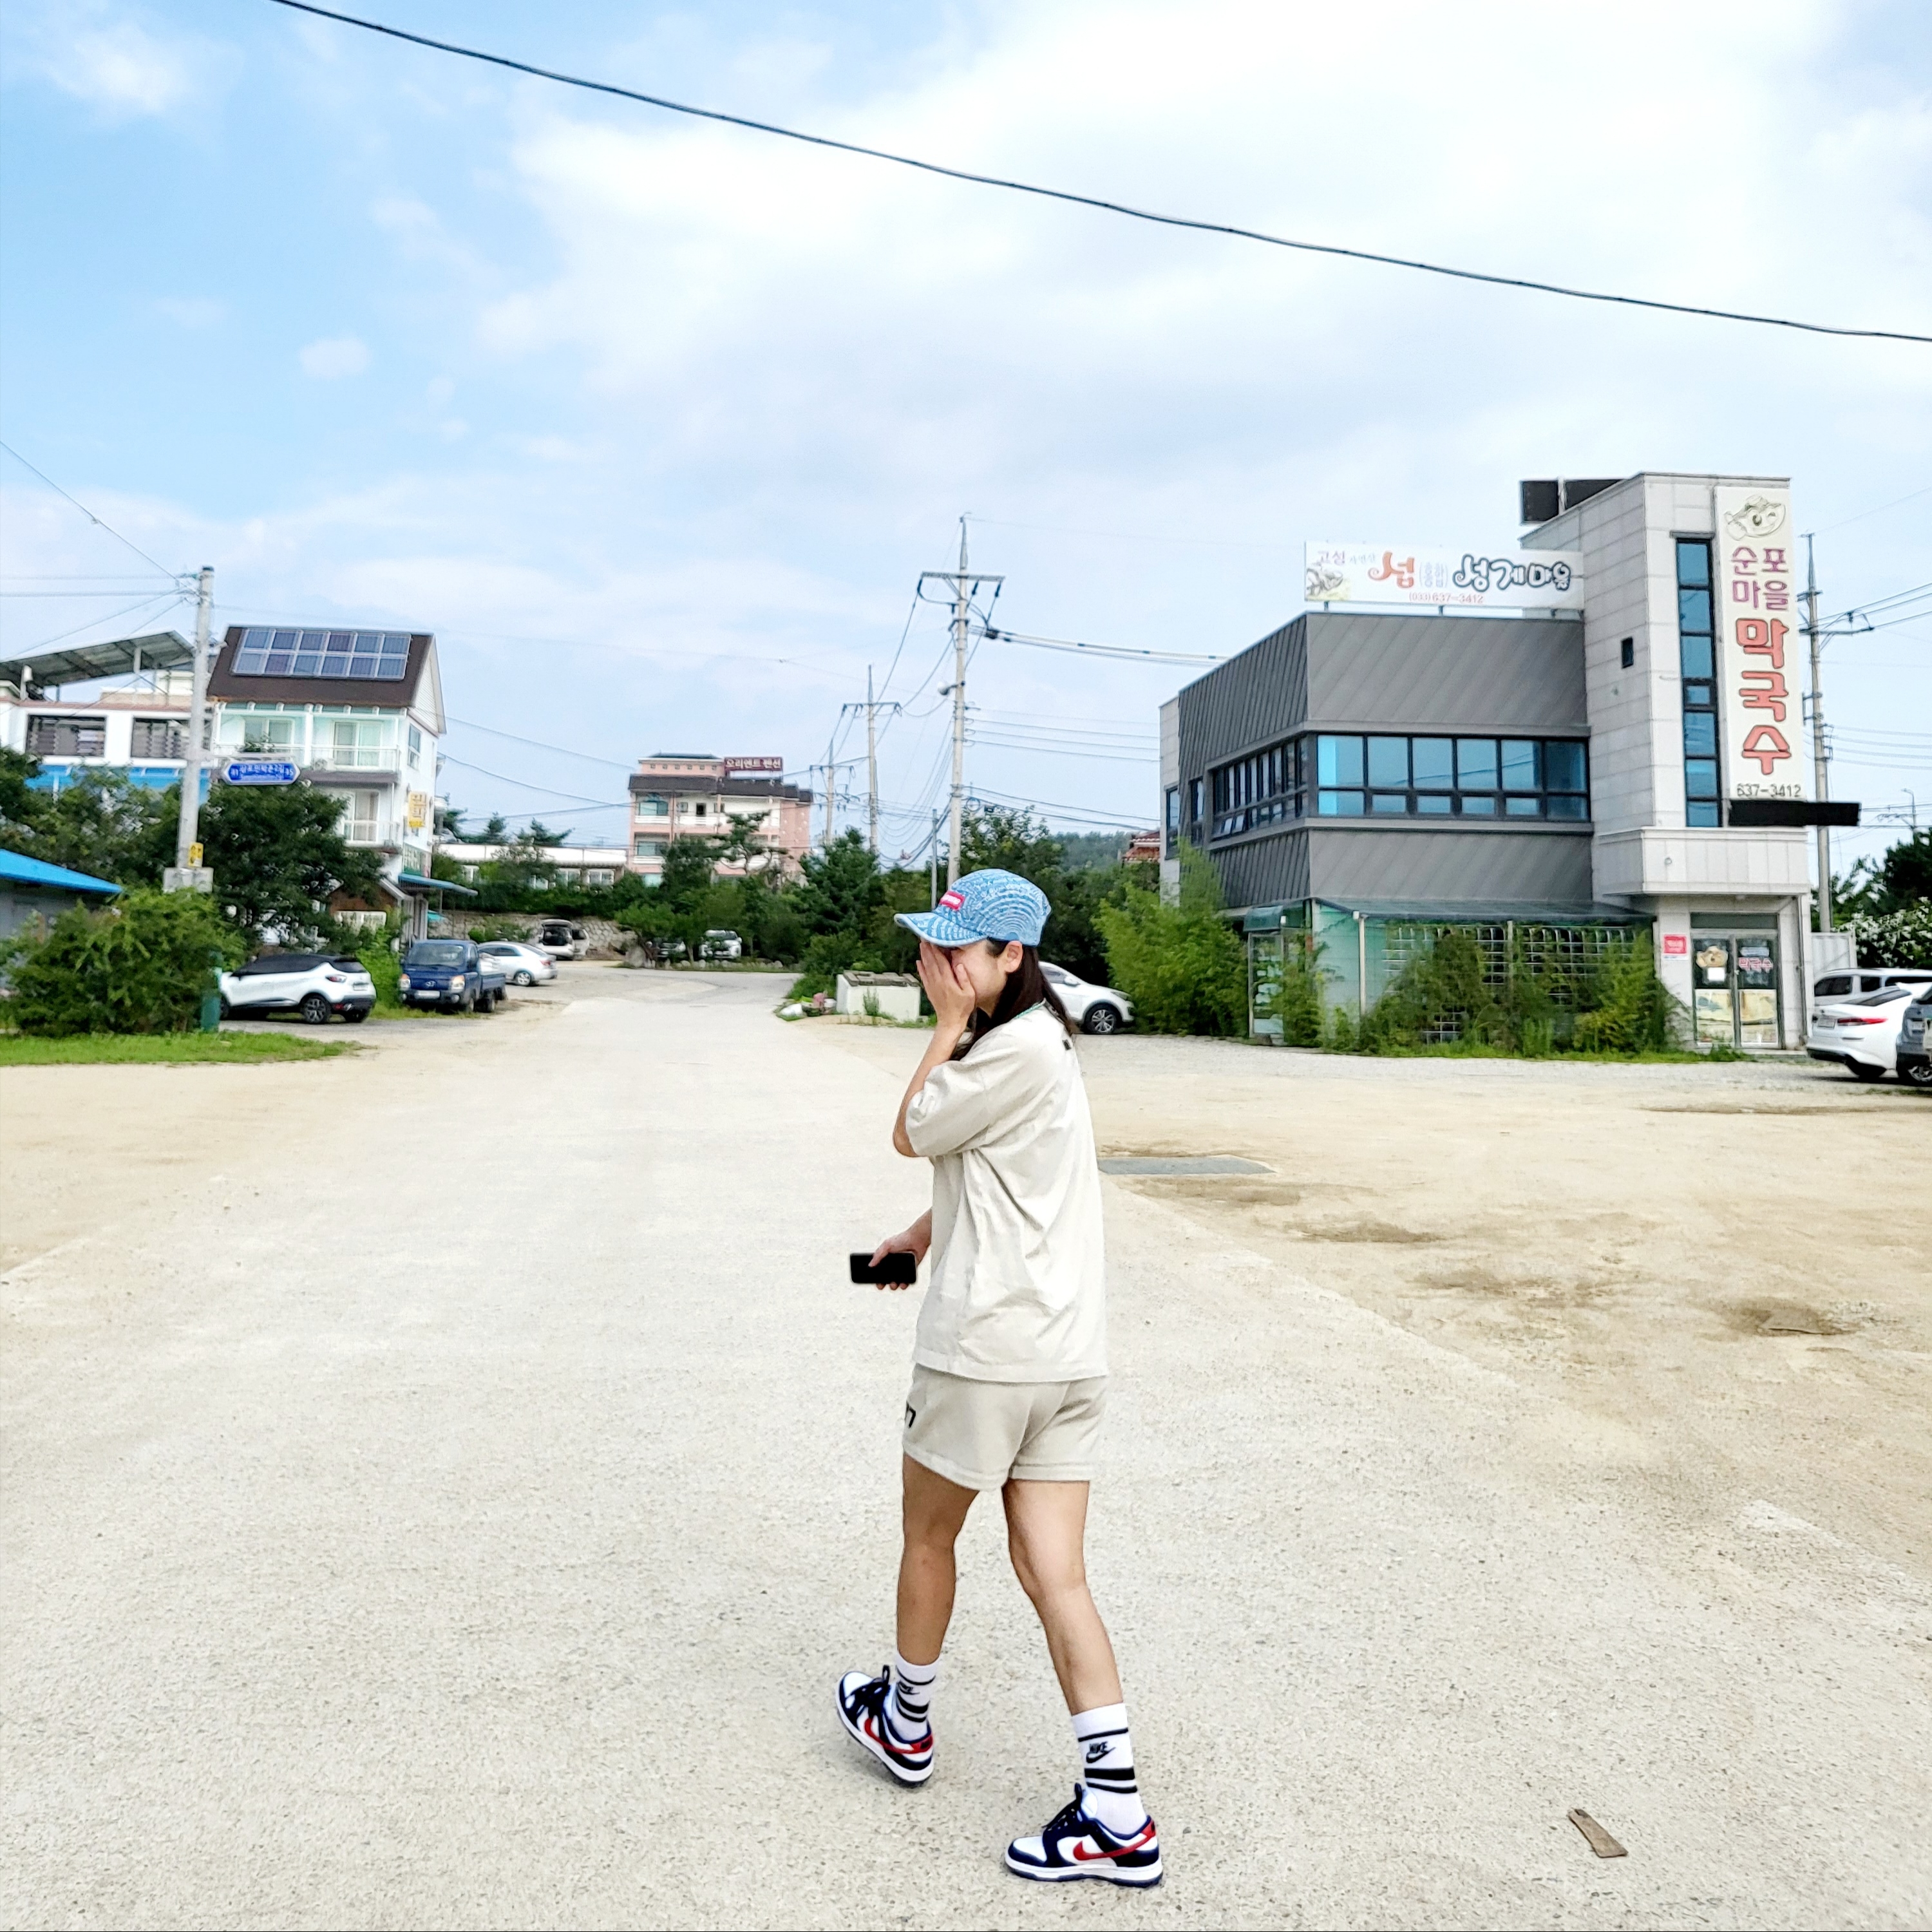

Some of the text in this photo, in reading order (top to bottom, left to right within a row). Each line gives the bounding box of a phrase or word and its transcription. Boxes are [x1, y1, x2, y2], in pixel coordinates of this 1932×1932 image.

[1732, 580, 1790, 611] 마을
[1736, 618, 1792, 775] 막국수
[1737, 783, 1801, 797] 637-3412
